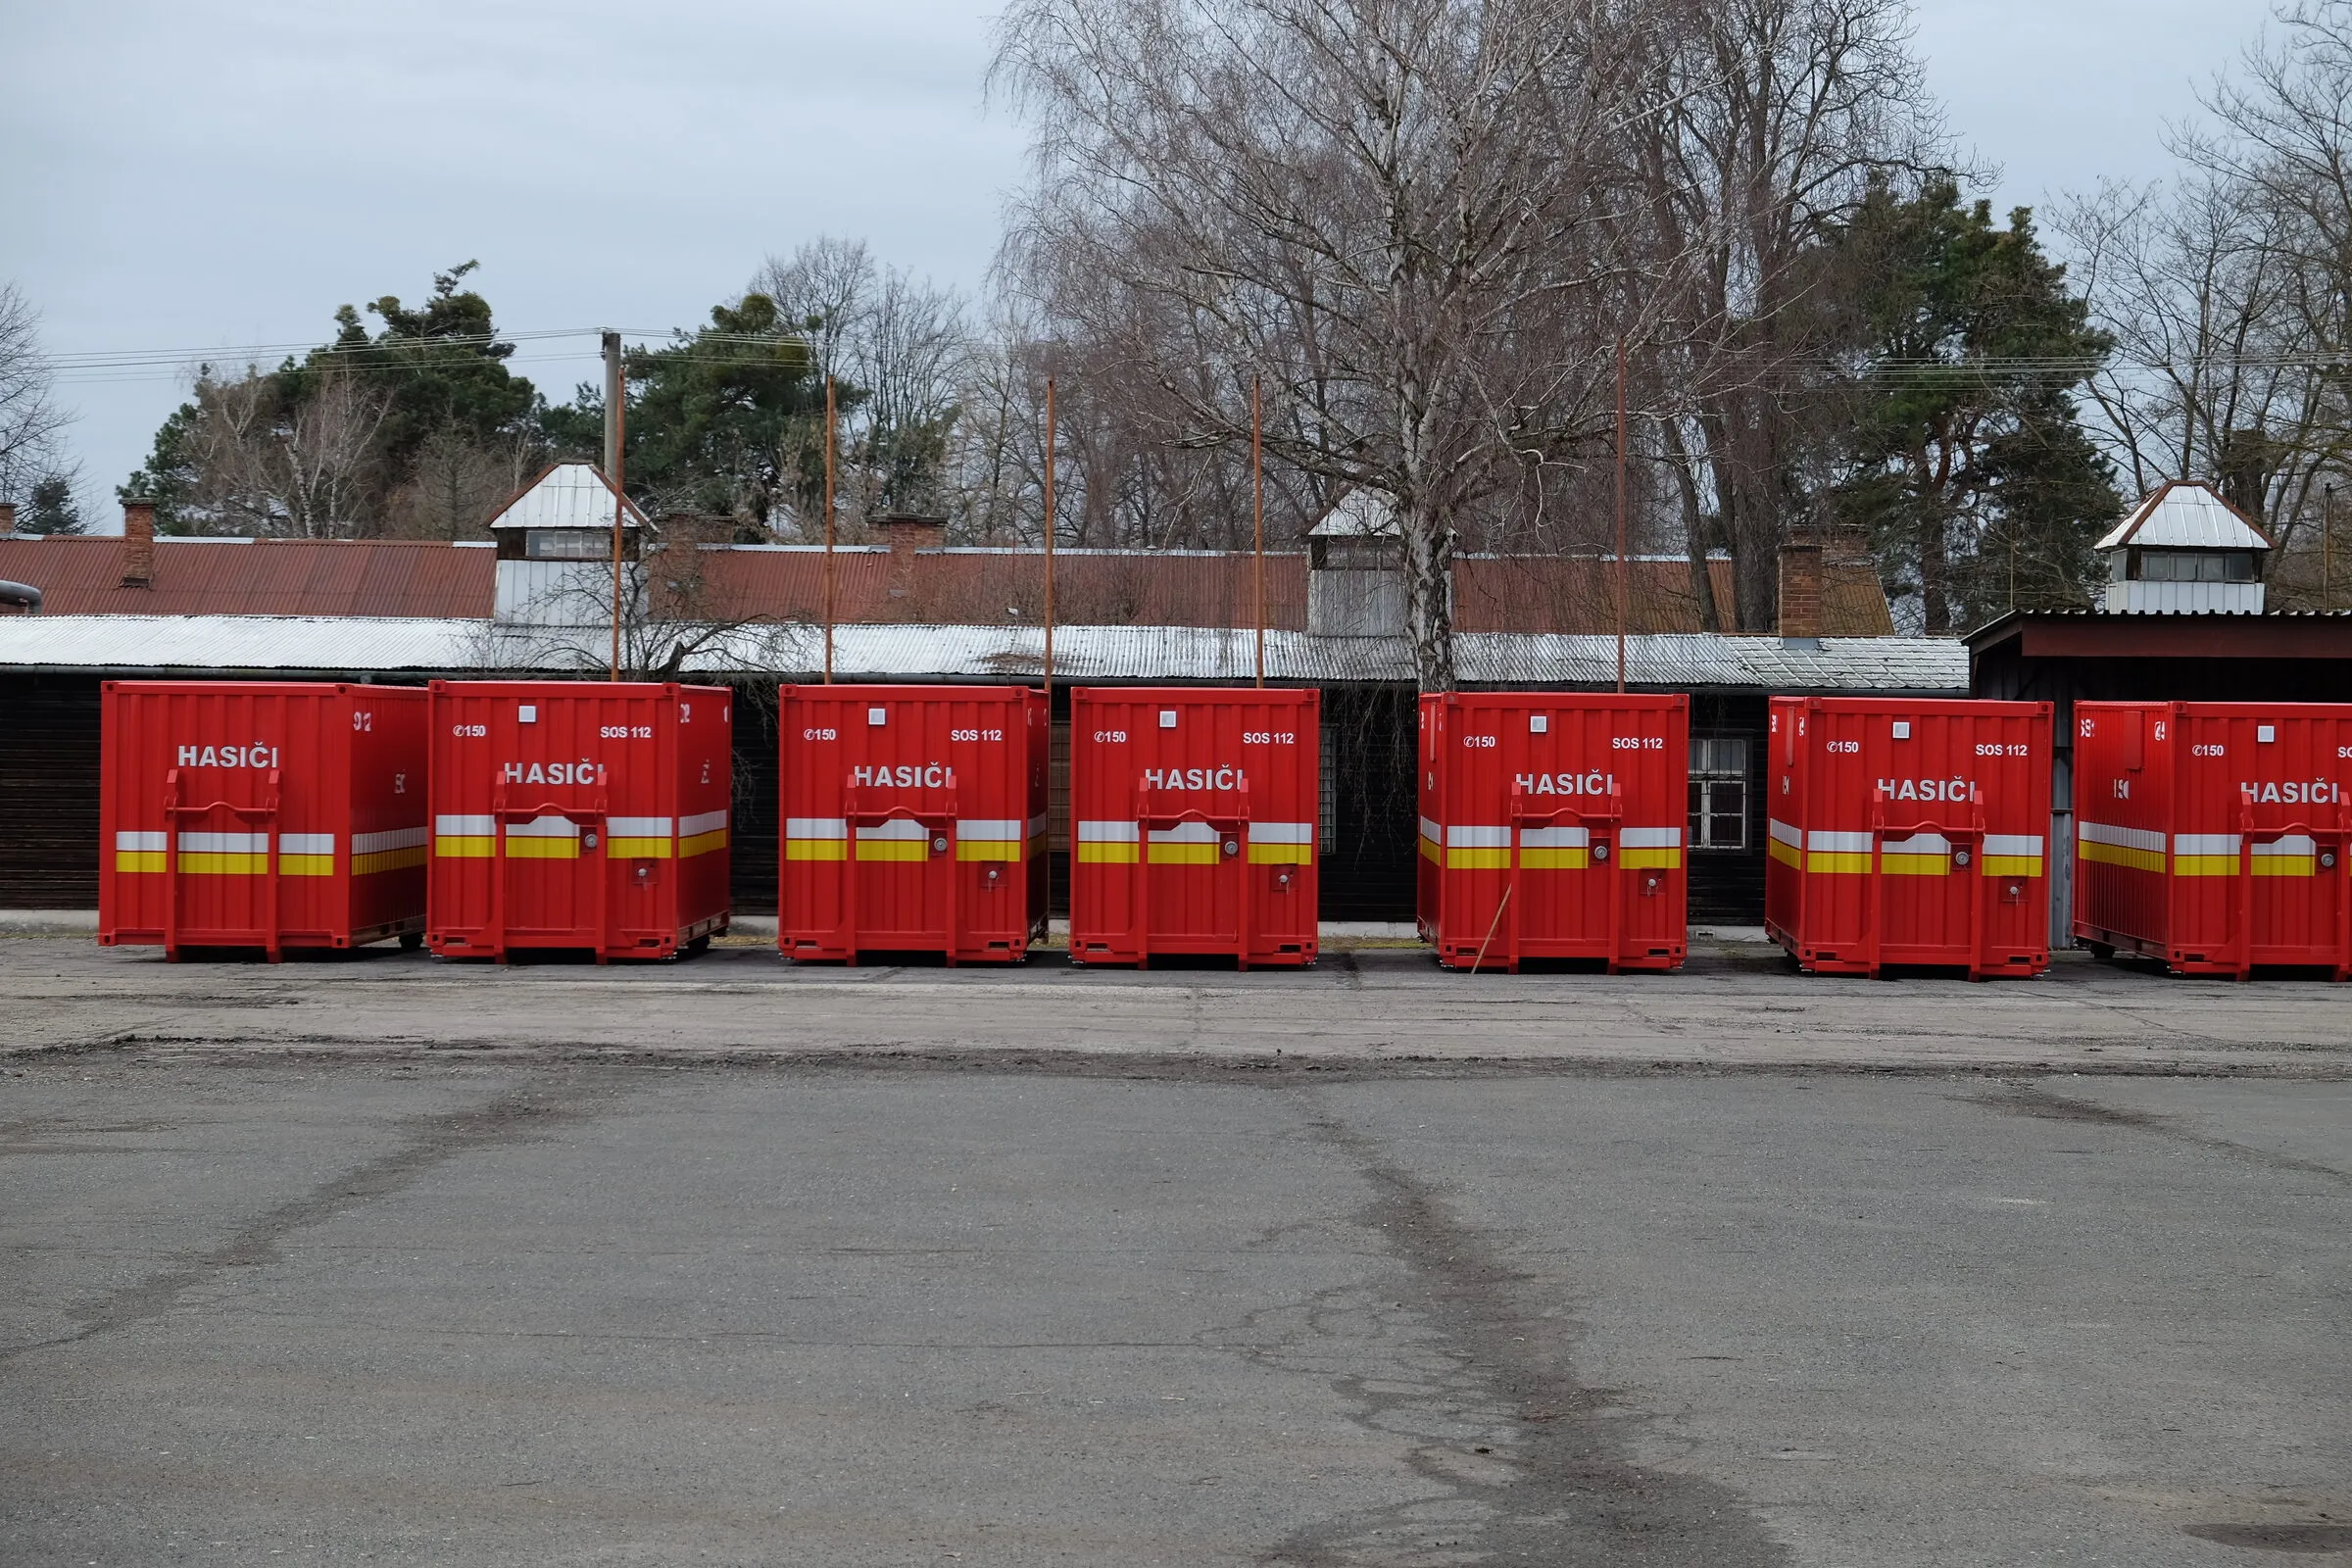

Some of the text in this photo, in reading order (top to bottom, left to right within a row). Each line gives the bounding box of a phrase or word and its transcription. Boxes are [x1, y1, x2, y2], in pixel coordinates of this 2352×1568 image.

[464, 724, 487, 737] 150
[600, 726, 652, 739] SOS 112
[814, 728, 837, 741] 150
[951, 729, 1003, 742] SOS 112
[1104, 730, 1127, 743] 150
[1244, 731, 1295, 745] SOS 112
[1473, 735, 1496, 748] 150
[1612, 737, 1663, 750] SOS 112
[1838, 741, 1859, 754] 150
[1975, 743, 2028, 757] SOS 112
[2202, 744, 2225, 757] 150
[177, 741, 279, 769] HASIČI
[854, 761, 953, 789] HASIČI
[1145, 763, 1245, 791] HASIČI
[1515, 768, 1616, 796] HASIČI
[1877, 775, 1976, 804] HASIČI
[2240, 777, 2338, 804] HASIČI
